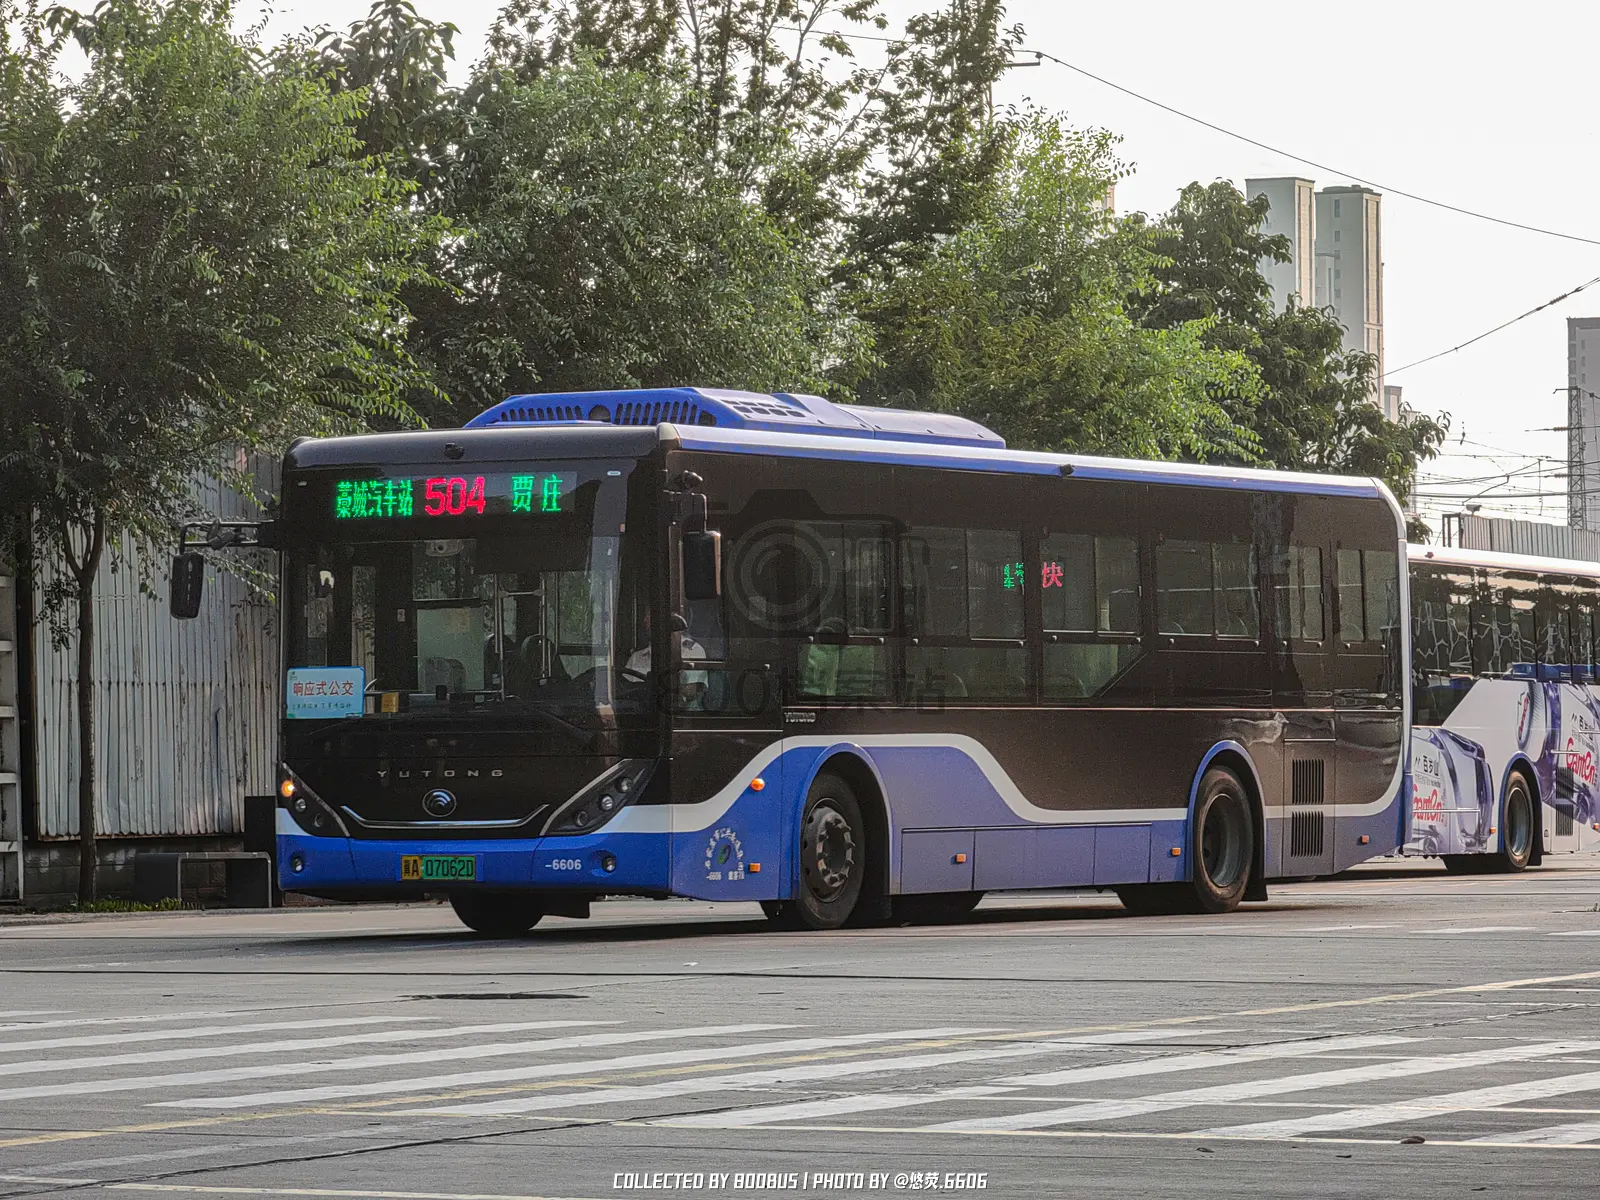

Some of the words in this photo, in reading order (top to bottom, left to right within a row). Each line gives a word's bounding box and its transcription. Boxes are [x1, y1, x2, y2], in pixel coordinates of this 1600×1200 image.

[425, 476, 486, 516] 504
[511, 474, 563, 513] 贾庄
[1041, 561, 1064, 588] 快
[293, 680, 354, 696] 响应式公交
[377, 769, 503, 778] YUTONG
